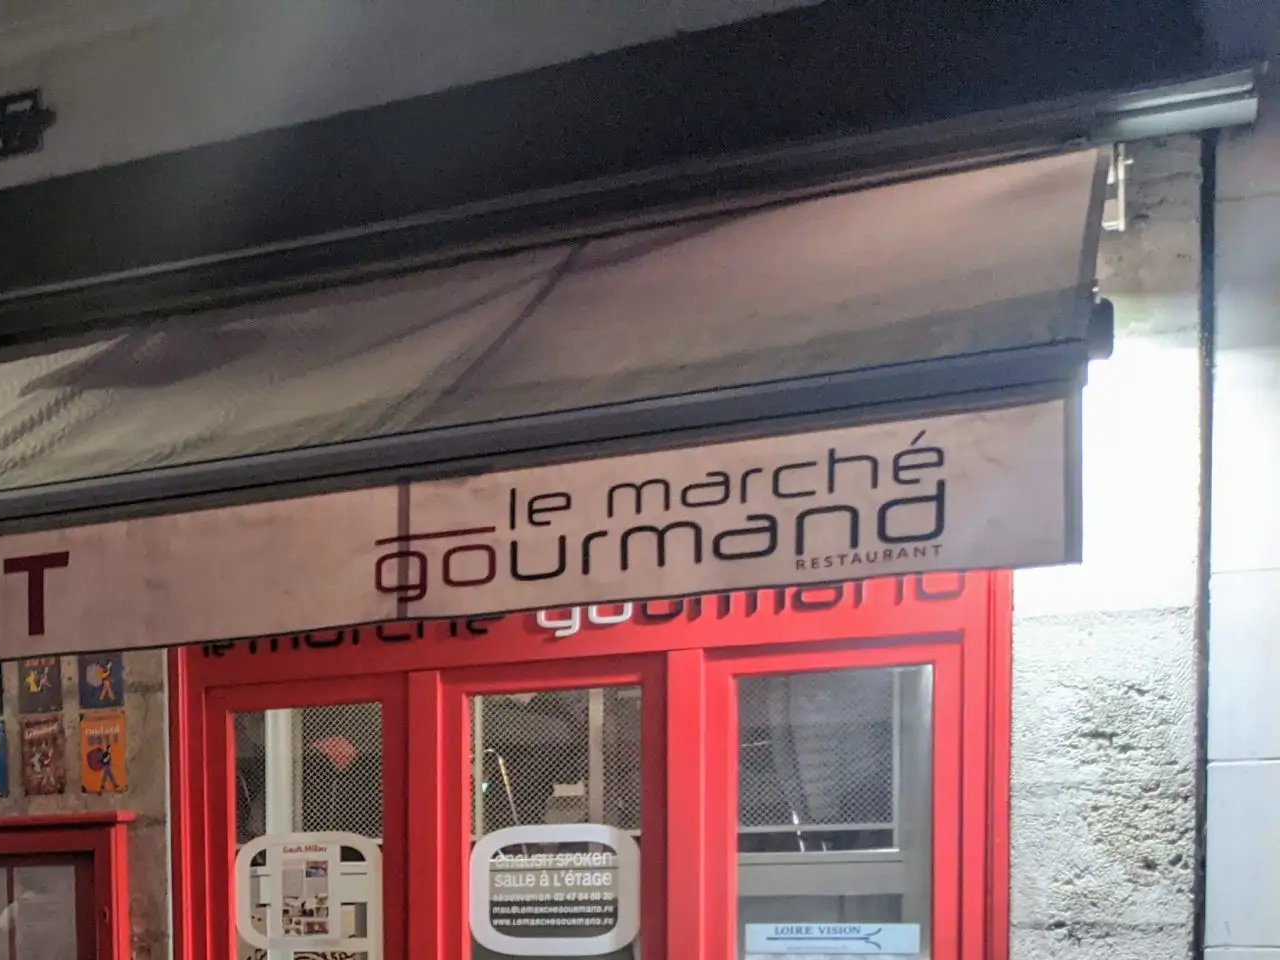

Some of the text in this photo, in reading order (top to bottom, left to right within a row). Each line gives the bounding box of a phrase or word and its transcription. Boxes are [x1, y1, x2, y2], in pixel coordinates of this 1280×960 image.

[508, 429, 945, 531] le marché
[374, 479, 946, 601] gourmand
[795, 543, 943, 570] RESTAURANT
[539, 869, 550, 887] à
[773, 924, 862, 936] LOIRE VISION
